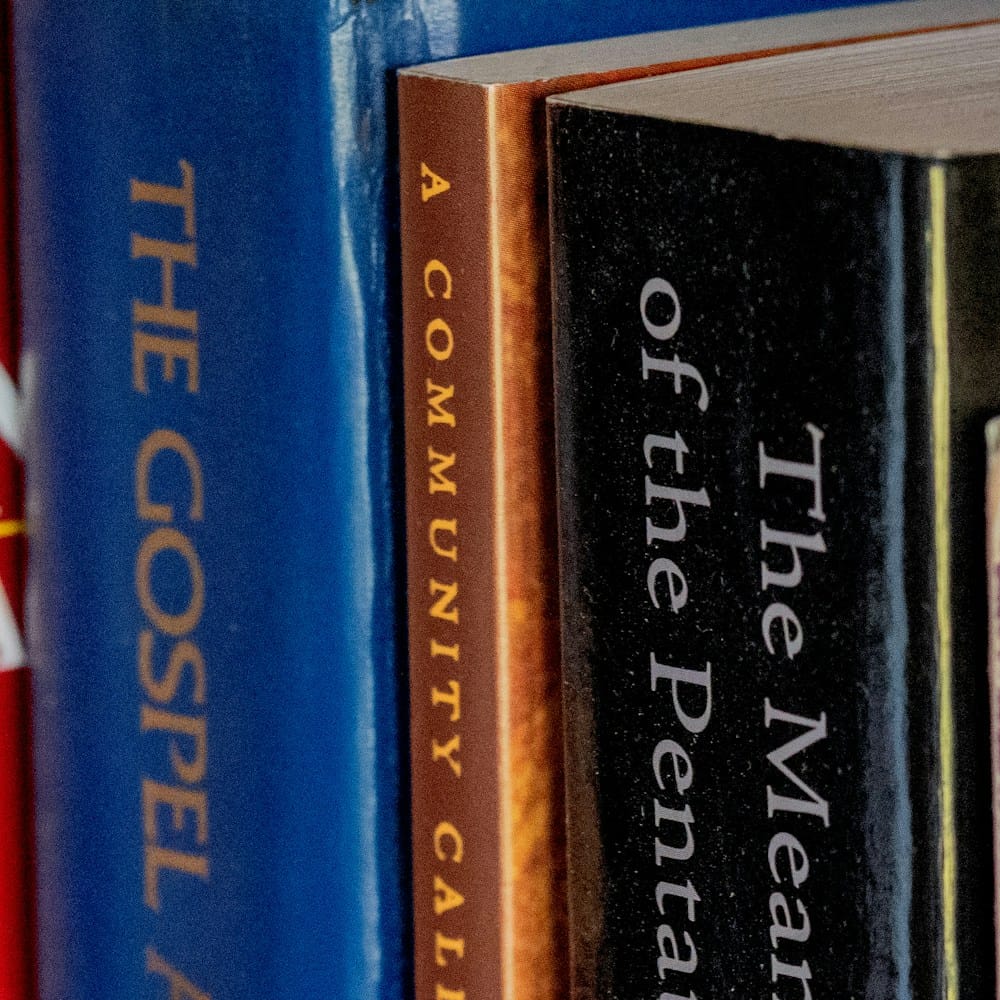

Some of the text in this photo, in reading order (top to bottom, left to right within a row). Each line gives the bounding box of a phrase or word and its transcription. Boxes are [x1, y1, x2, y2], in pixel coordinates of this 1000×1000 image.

[129, 159, 199, 393] THE
[420, 162, 451, 202] A
[640, 277, 709, 412] of
[423, 258, 463, 777] COMMUNITY
[643, 430, 711, 613] the
[758, 422, 828, 659] The
[135, 428, 209, 911] GOSPEL
